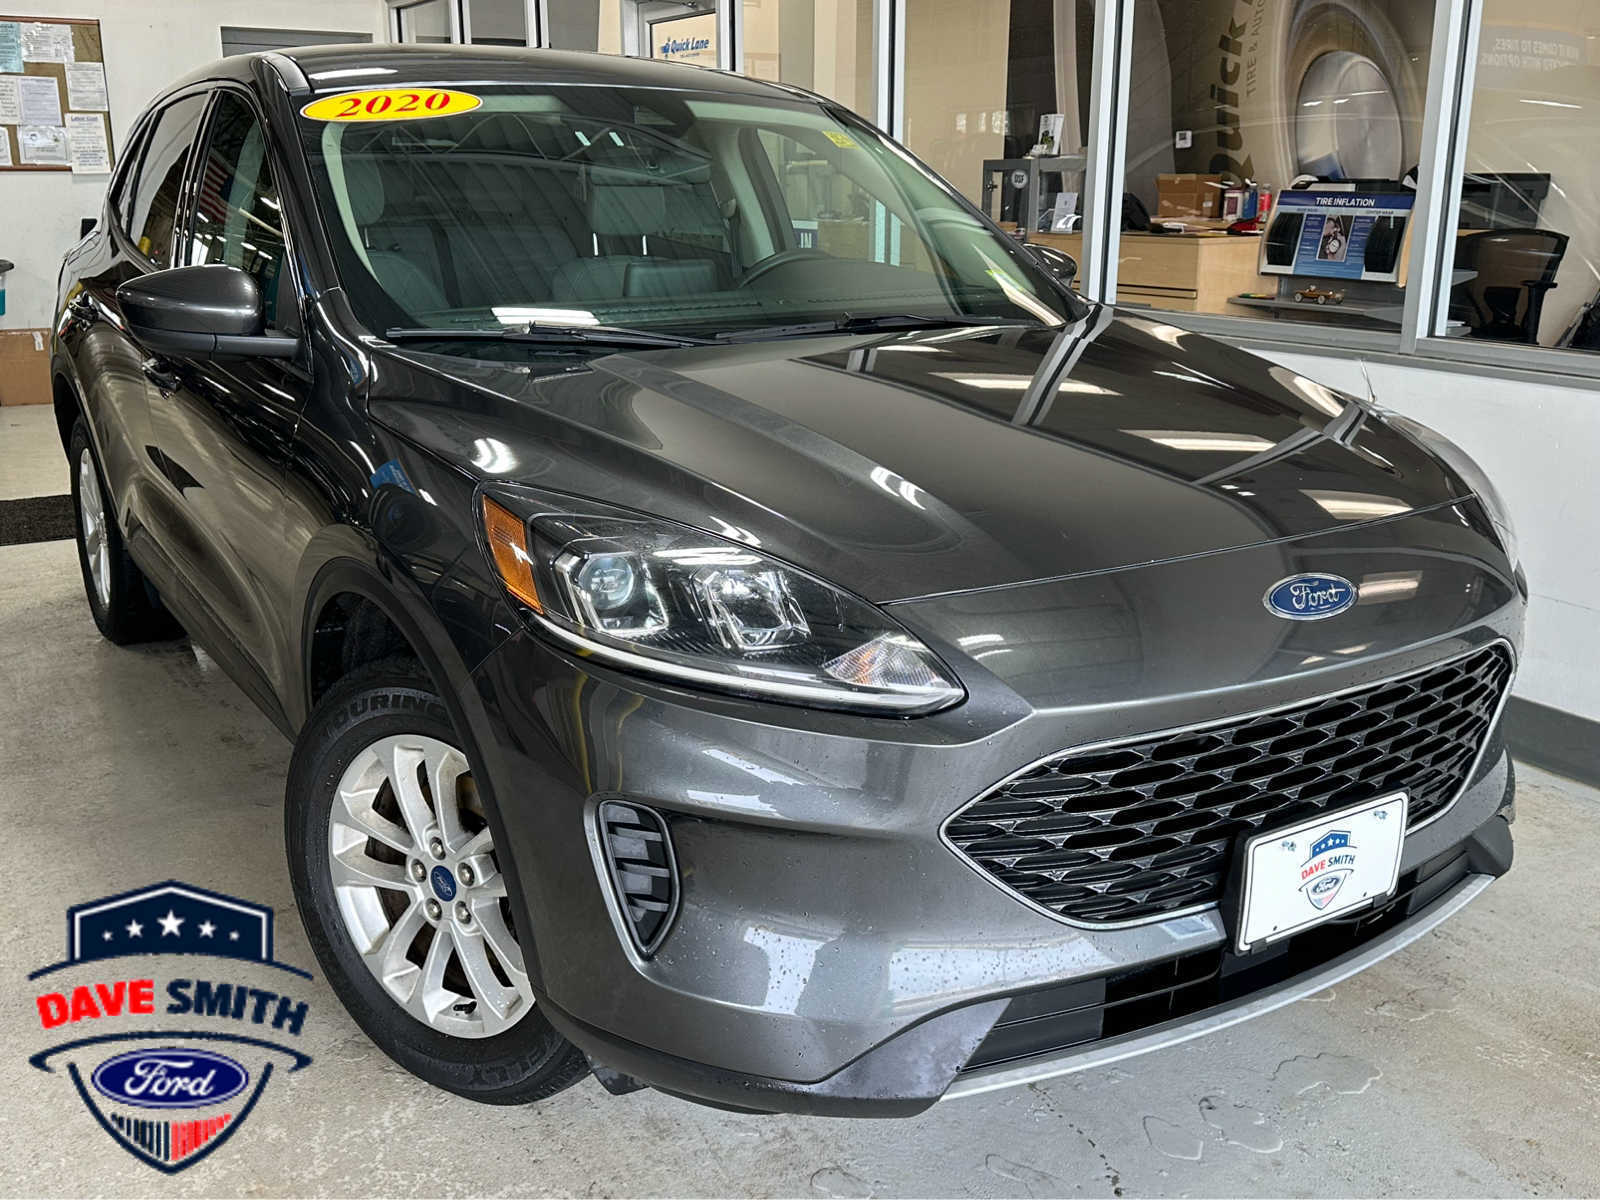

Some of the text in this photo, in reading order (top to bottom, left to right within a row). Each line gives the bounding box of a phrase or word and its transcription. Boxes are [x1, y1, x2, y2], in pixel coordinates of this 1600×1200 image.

[670, 37, 709, 54] Quick Lane
[1246, 58, 1257, 97] TIRE
[336, 93, 450, 118] 2020
[1315, 197, 1375, 207] TIRE INFLATION
[1290, 580, 1345, 609] Ford
[1301, 854, 1356, 880] DAVE SMITH
